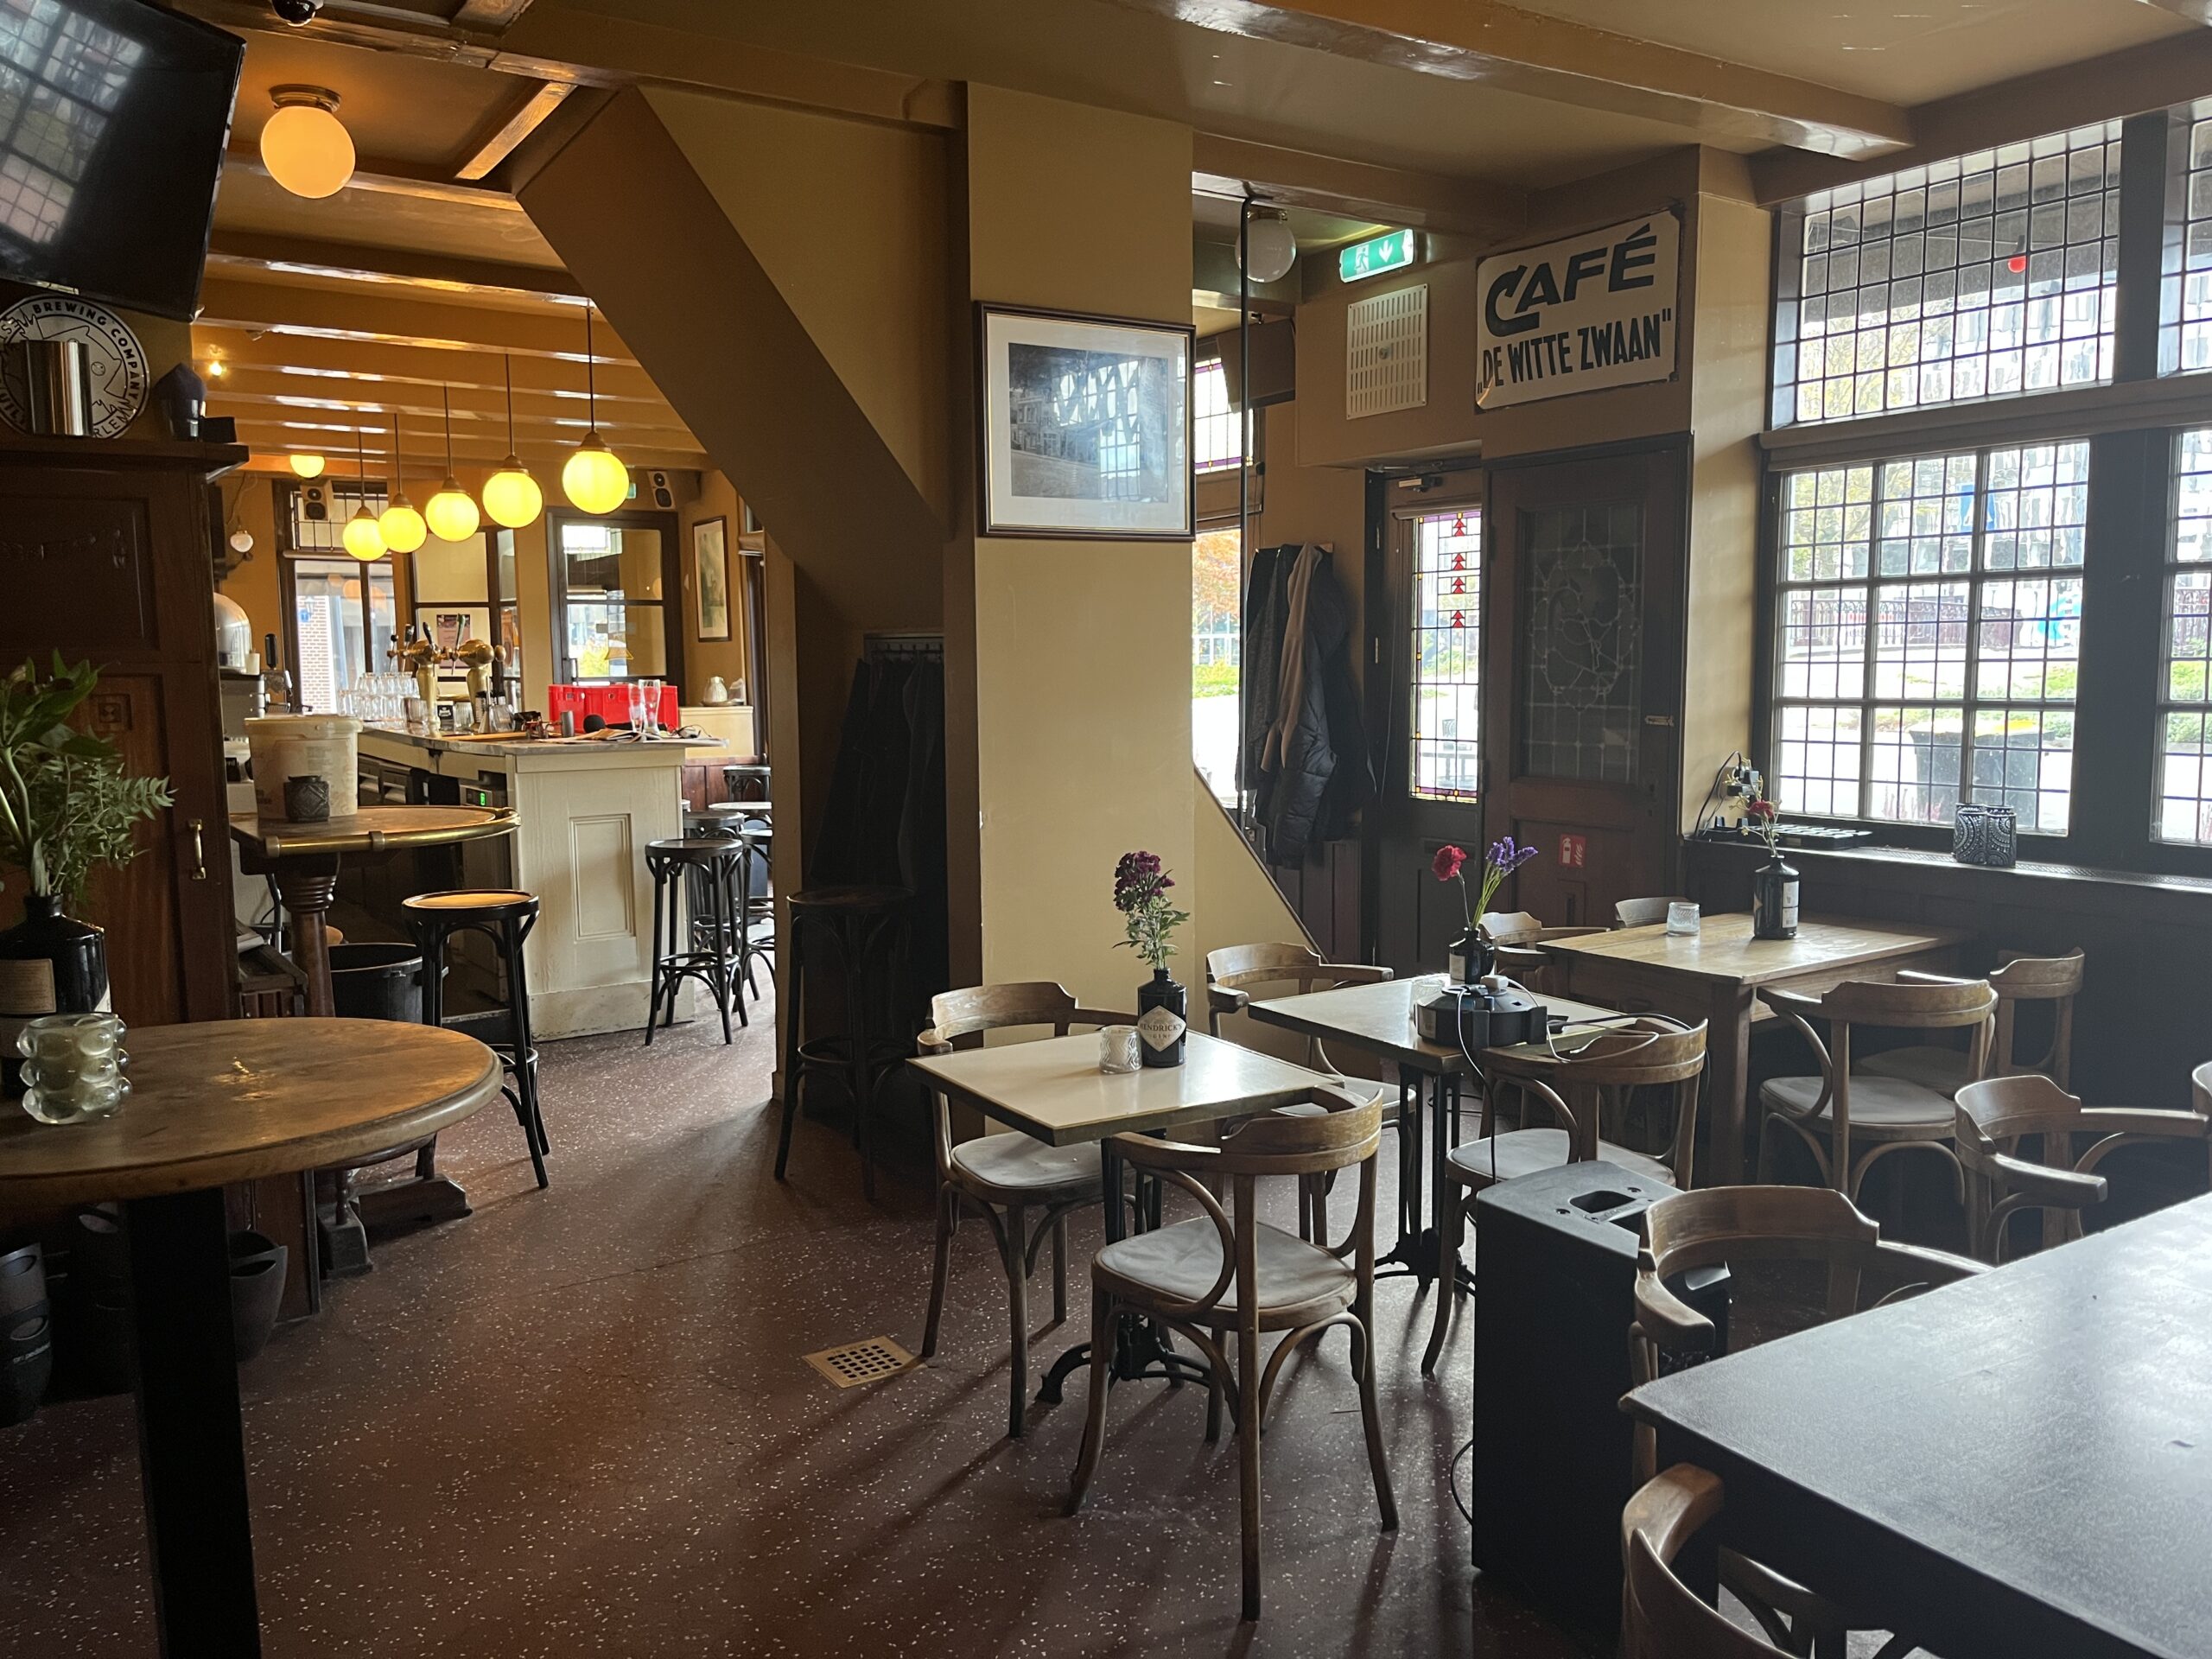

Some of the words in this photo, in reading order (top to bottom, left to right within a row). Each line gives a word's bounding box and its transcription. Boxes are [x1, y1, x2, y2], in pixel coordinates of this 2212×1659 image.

[1484, 222, 1657, 338] CAFÉ
[32, 300, 107, 327] BREWING
[111, 327, 141, 401] COMPANY
[1507, 331, 1573, 384] WITTE
